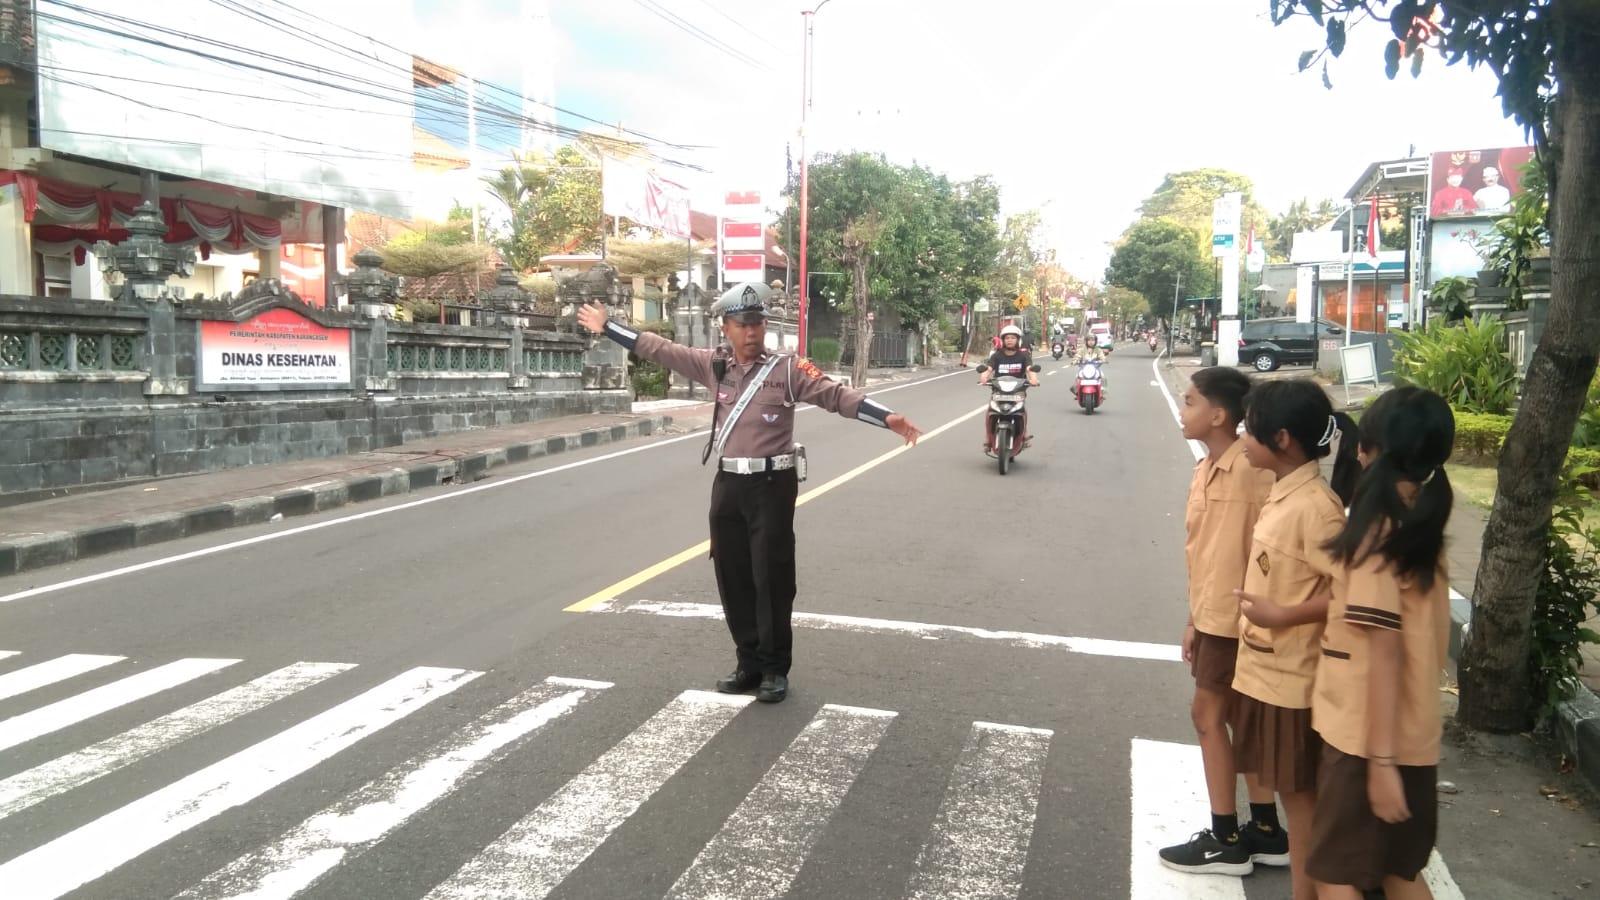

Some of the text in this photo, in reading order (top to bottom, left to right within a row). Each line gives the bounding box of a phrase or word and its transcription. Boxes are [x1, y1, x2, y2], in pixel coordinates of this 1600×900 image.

[266, 332, 296, 340] KABUPATEN
[222, 352, 336, 367] DINAS KESEHATAN
